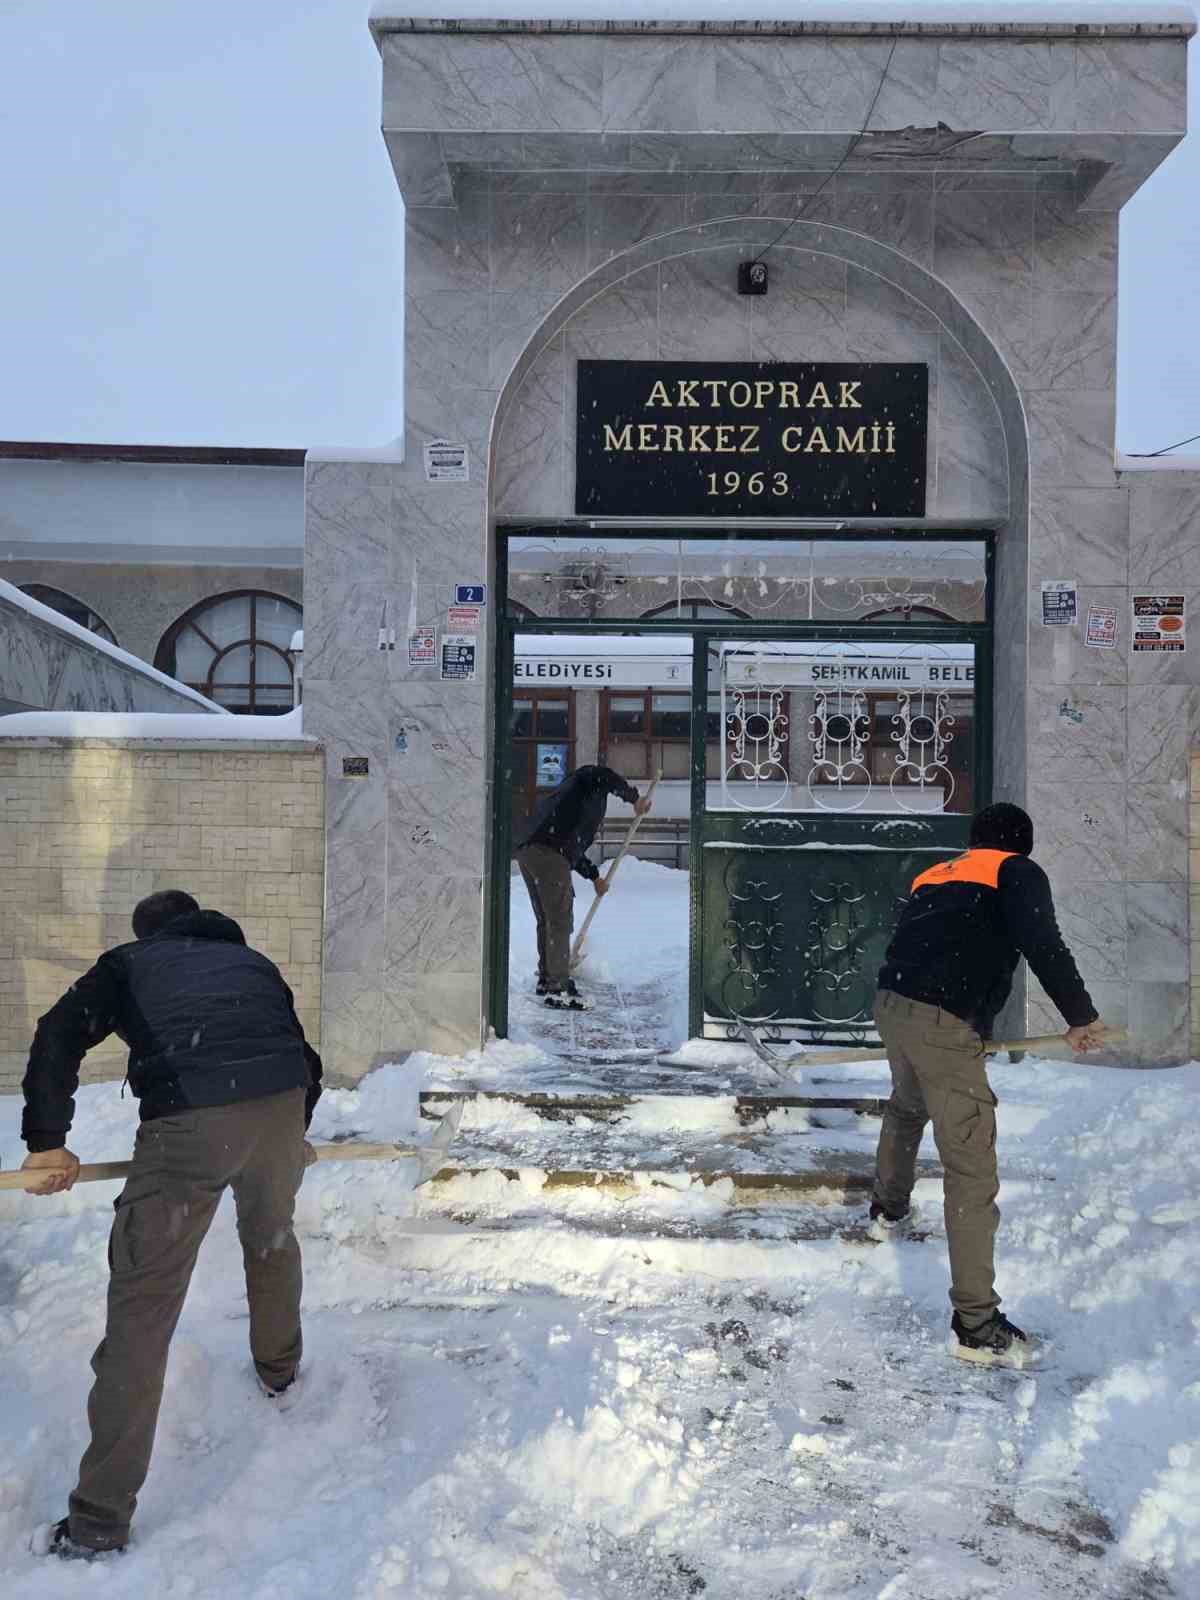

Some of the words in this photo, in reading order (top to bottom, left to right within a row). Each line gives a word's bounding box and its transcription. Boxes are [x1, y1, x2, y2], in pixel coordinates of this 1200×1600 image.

[645, 380, 862, 408] AKTOPRAK
[603, 424, 760, 452] MERKEZ
[781, 421, 896, 453] CAMİİ
[706, 472, 789, 495] 1963
[466, 588, 474, 601] 2
